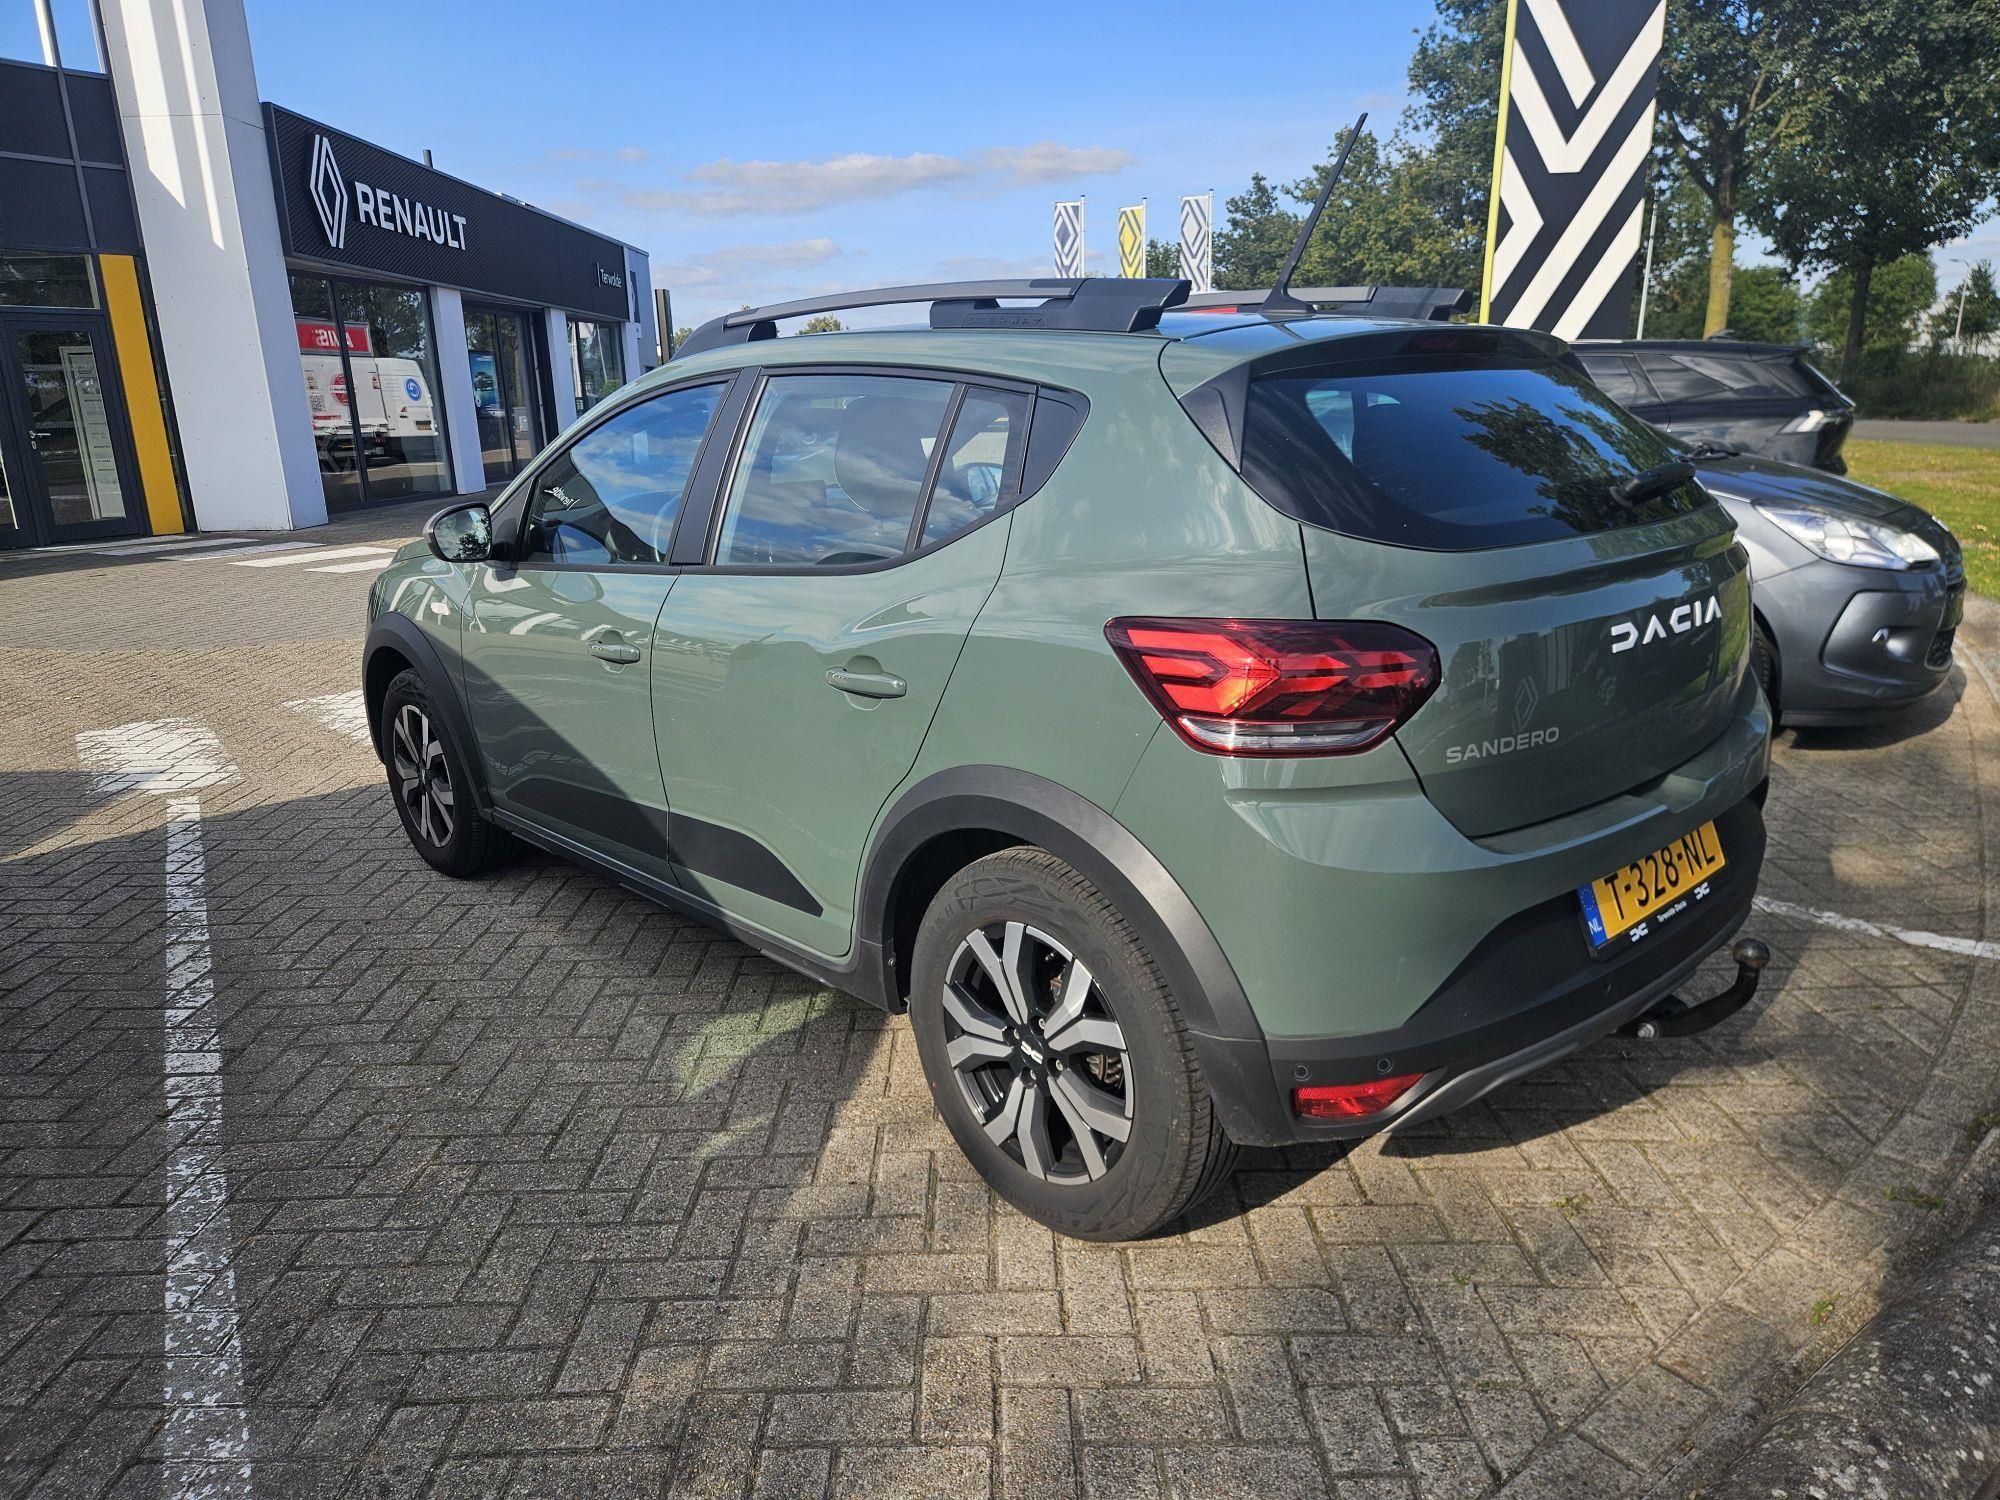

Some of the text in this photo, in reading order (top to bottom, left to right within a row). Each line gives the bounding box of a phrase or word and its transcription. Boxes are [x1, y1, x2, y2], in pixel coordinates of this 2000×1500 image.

[354, 181, 467, 251] RENAULT
[1610, 595, 1722, 654] DACIA
[1446, 726, 1559, 764] SANDERO
[1588, 828, 1716, 936] NL T-328-NL
